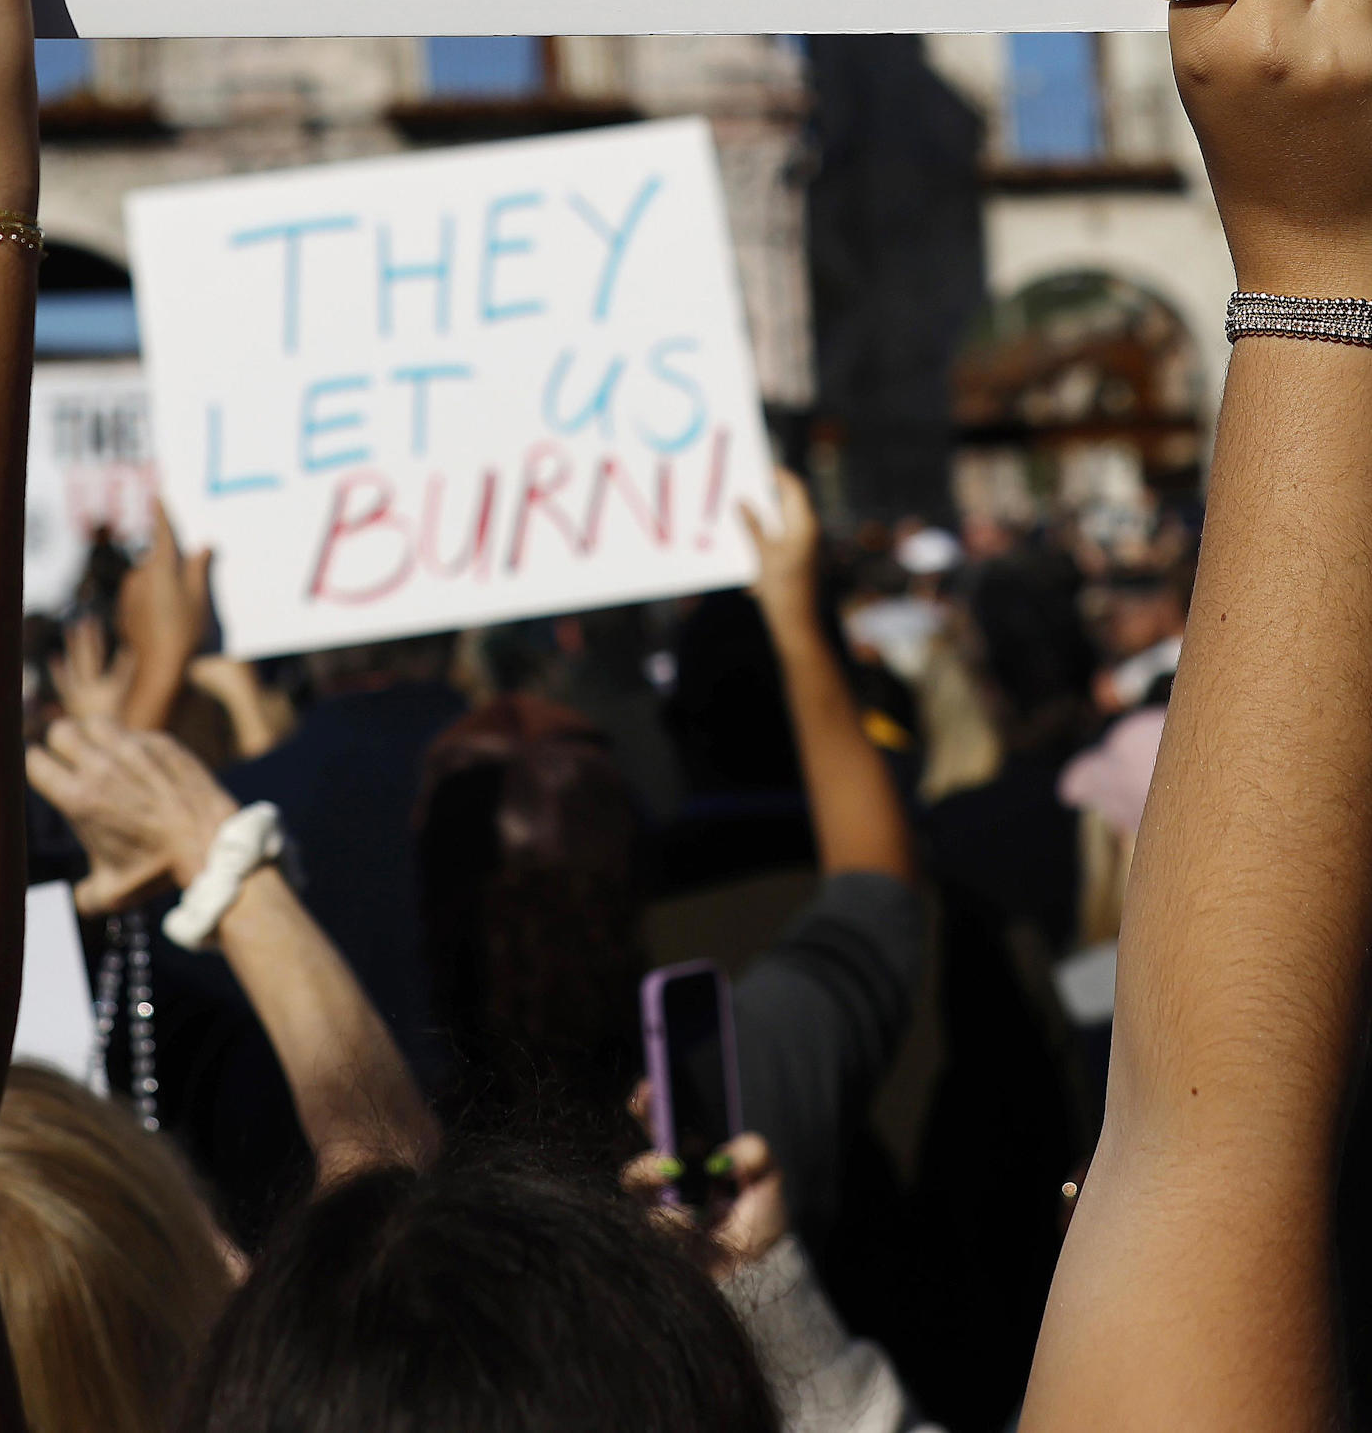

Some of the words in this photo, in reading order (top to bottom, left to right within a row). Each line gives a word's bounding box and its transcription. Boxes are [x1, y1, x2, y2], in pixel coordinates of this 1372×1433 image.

[227, 176, 663, 356] THEY
[205, 362, 472, 497] LET
[540, 337, 709, 453] US
[304, 426, 732, 608] BURN!
